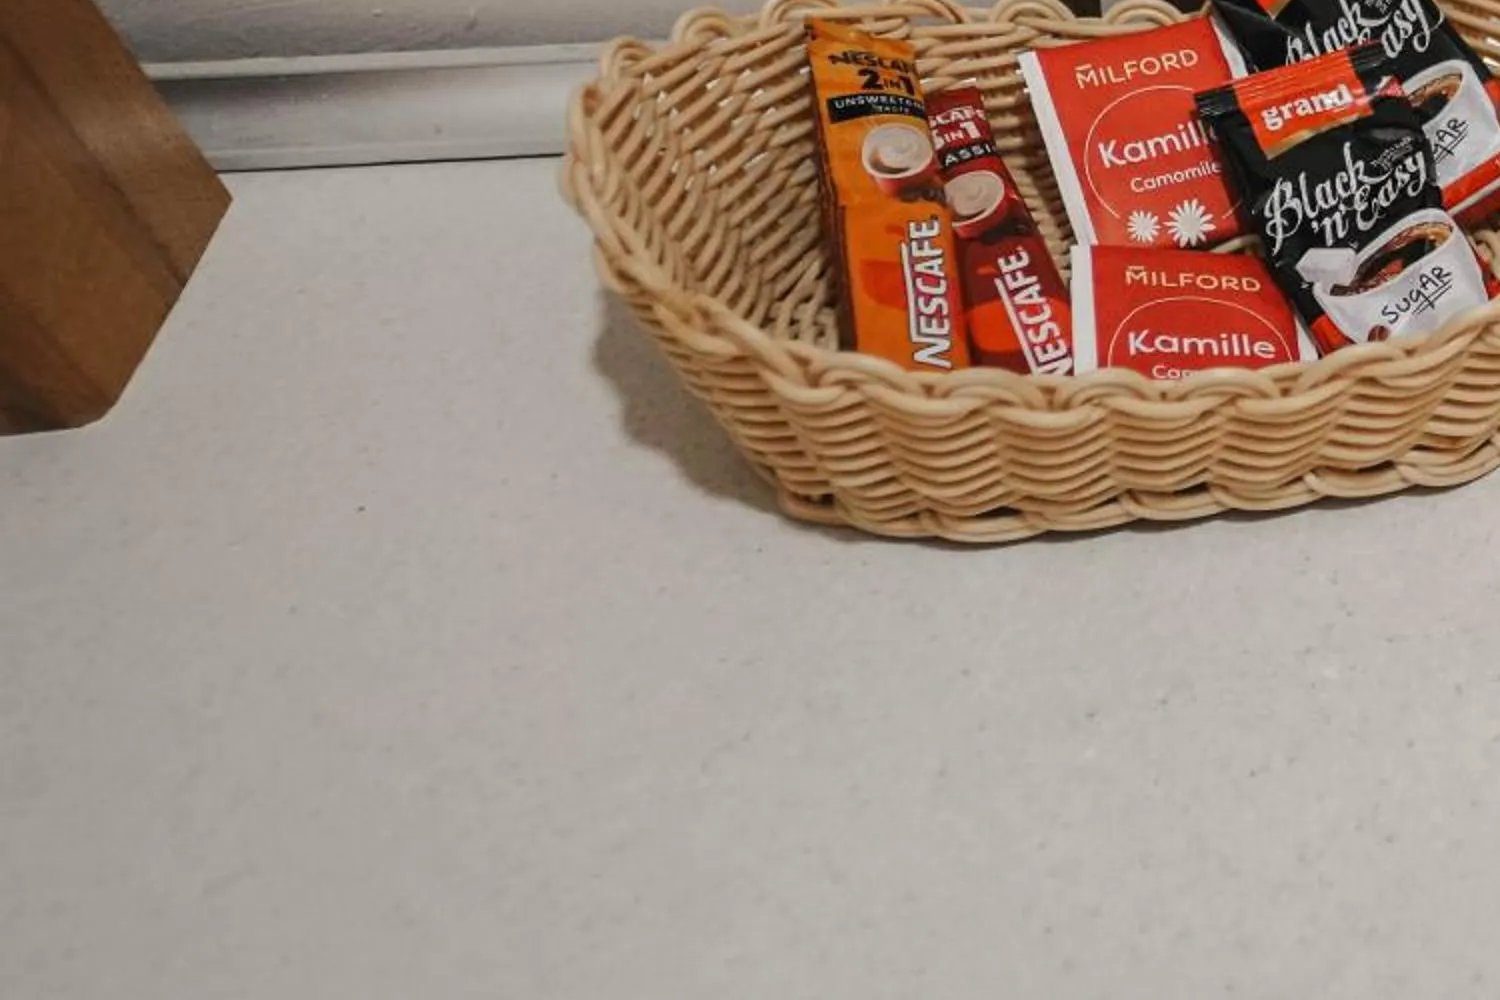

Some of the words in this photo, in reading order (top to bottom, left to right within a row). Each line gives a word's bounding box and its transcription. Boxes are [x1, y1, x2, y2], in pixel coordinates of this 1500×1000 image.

[1075, 49, 1199, 89] MILFORD
[1261, 83, 1355, 131] grand
[1264, 141, 1393, 257] Black
[1350, 151, 1427, 231] Easy
[1124, 265, 1262, 292] MILFORD
[1127, 328, 1277, 360] Kamille
